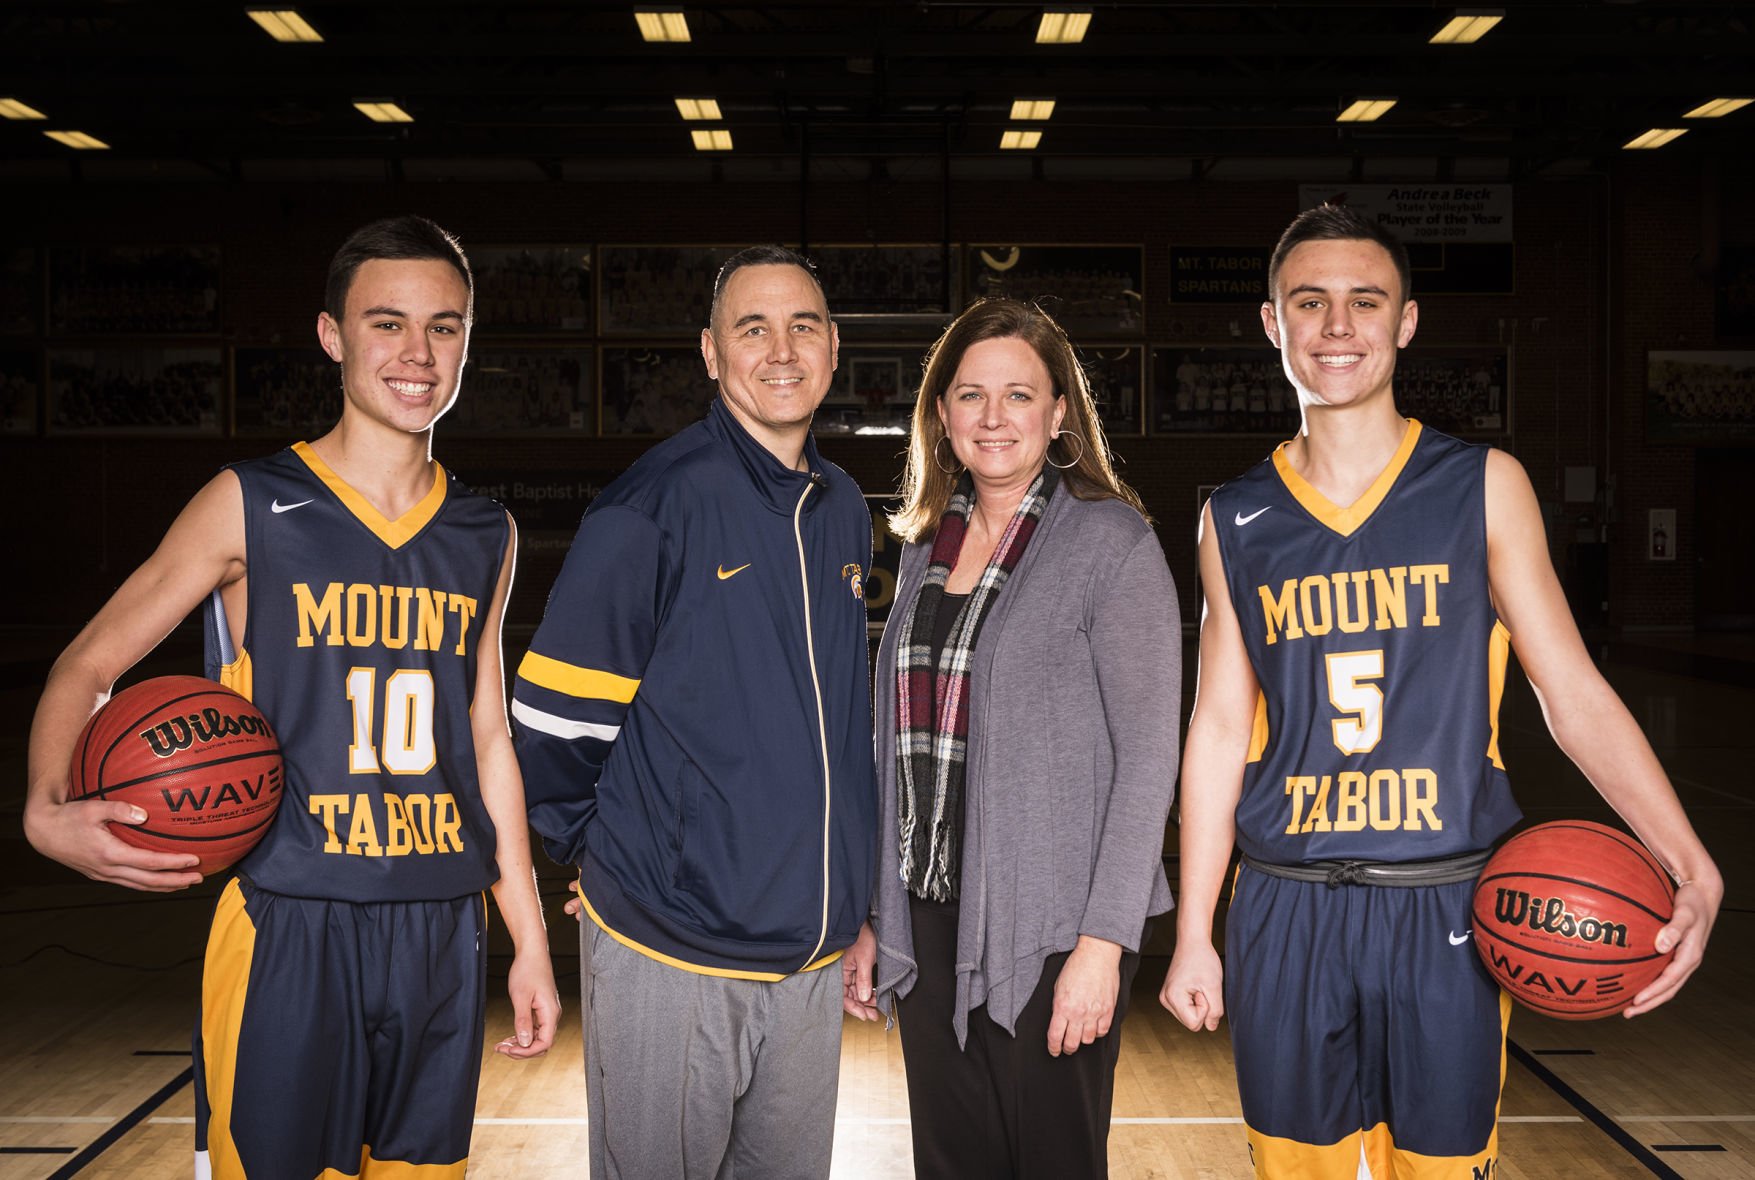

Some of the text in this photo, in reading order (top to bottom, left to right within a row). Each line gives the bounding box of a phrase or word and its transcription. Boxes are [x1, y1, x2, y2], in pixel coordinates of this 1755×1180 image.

[1377, 213, 1503, 227] Player of the Year
[1388, 188, 1491, 200] Andrea Beck
[1396, 202, 1484, 214] State Volleyball
[1177, 280, 1264, 294] SPARTANS
[1207, 256, 1263, 271] TABOR
[513, 482, 574, 501] Baptist
[292, 582, 478, 656] MOUNT
[1258, 564, 1450, 645] MOUNT
[345, 666, 437, 775] 10
[1325, 649, 1384, 756] 5
[139, 707, 272, 758] Wilson
[161, 766, 281, 812] WAVE
[1285, 768, 1443, 834] TABOR
[309, 793, 465, 857] TABOR
[1495, 887, 1628, 948] Wilson
[1489, 943, 1625, 996] WAVE
